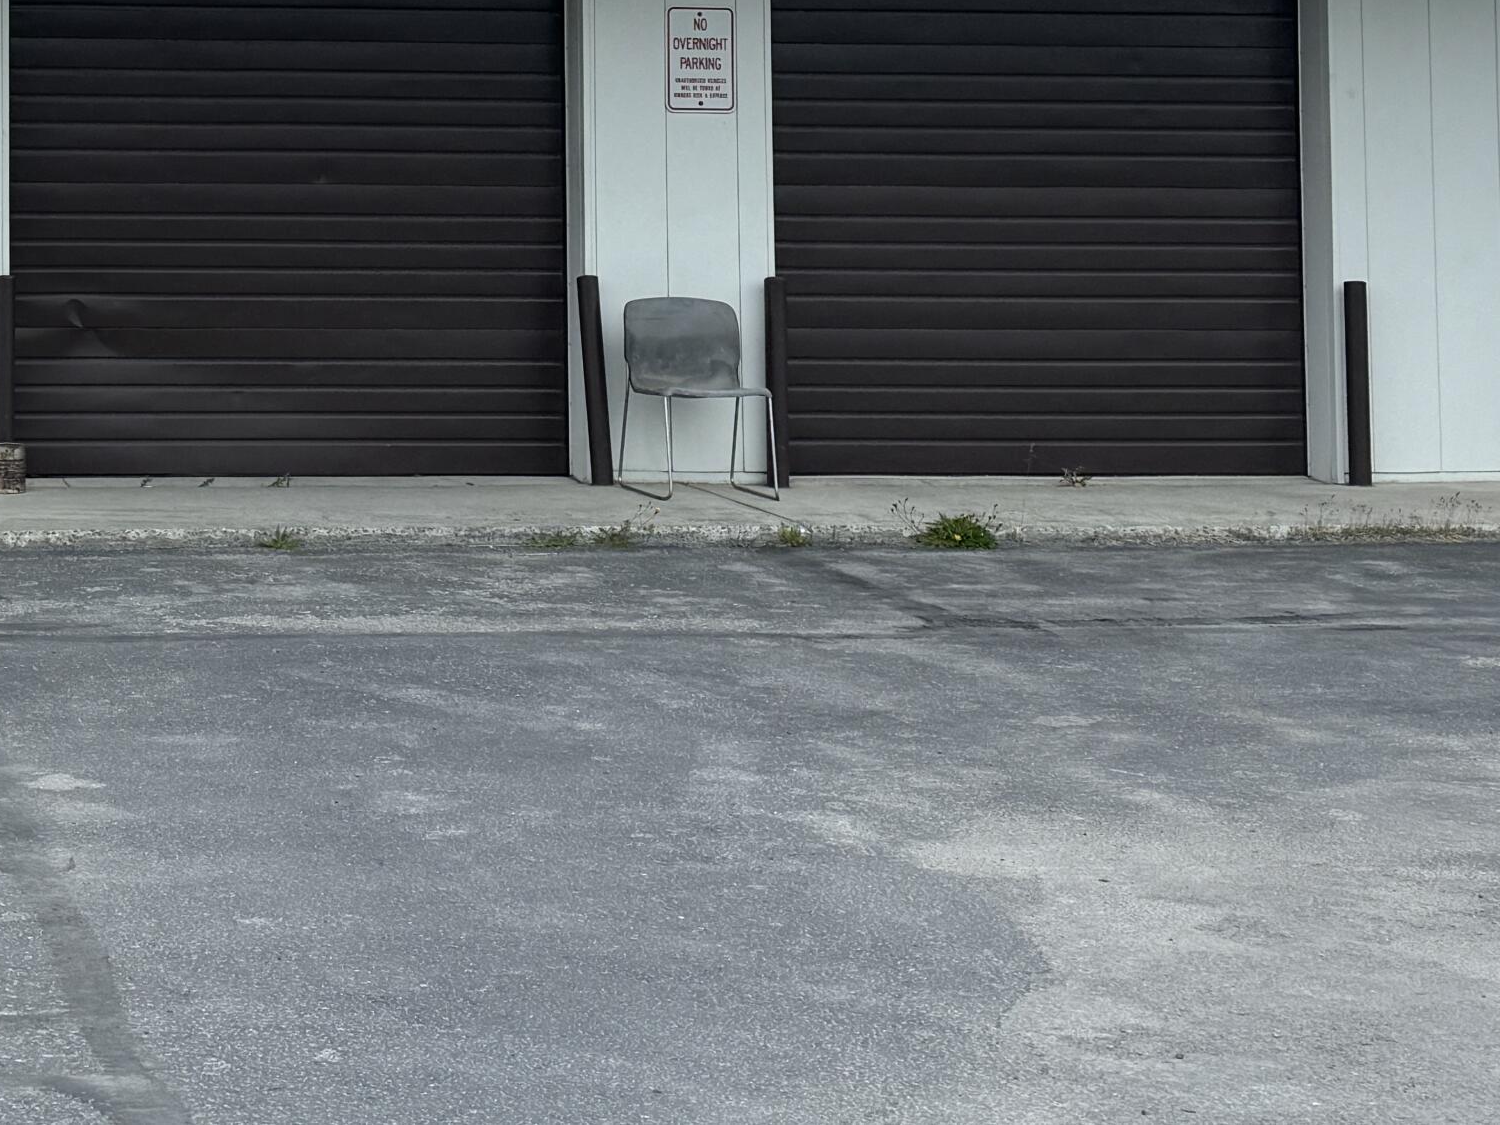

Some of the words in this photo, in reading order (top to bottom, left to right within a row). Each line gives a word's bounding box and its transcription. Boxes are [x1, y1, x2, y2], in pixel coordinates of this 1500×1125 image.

[693, 18, 708, 31] NO
[673, 37, 728, 51] OVERNIGHT
[680, 57, 722, 70] PARKING
